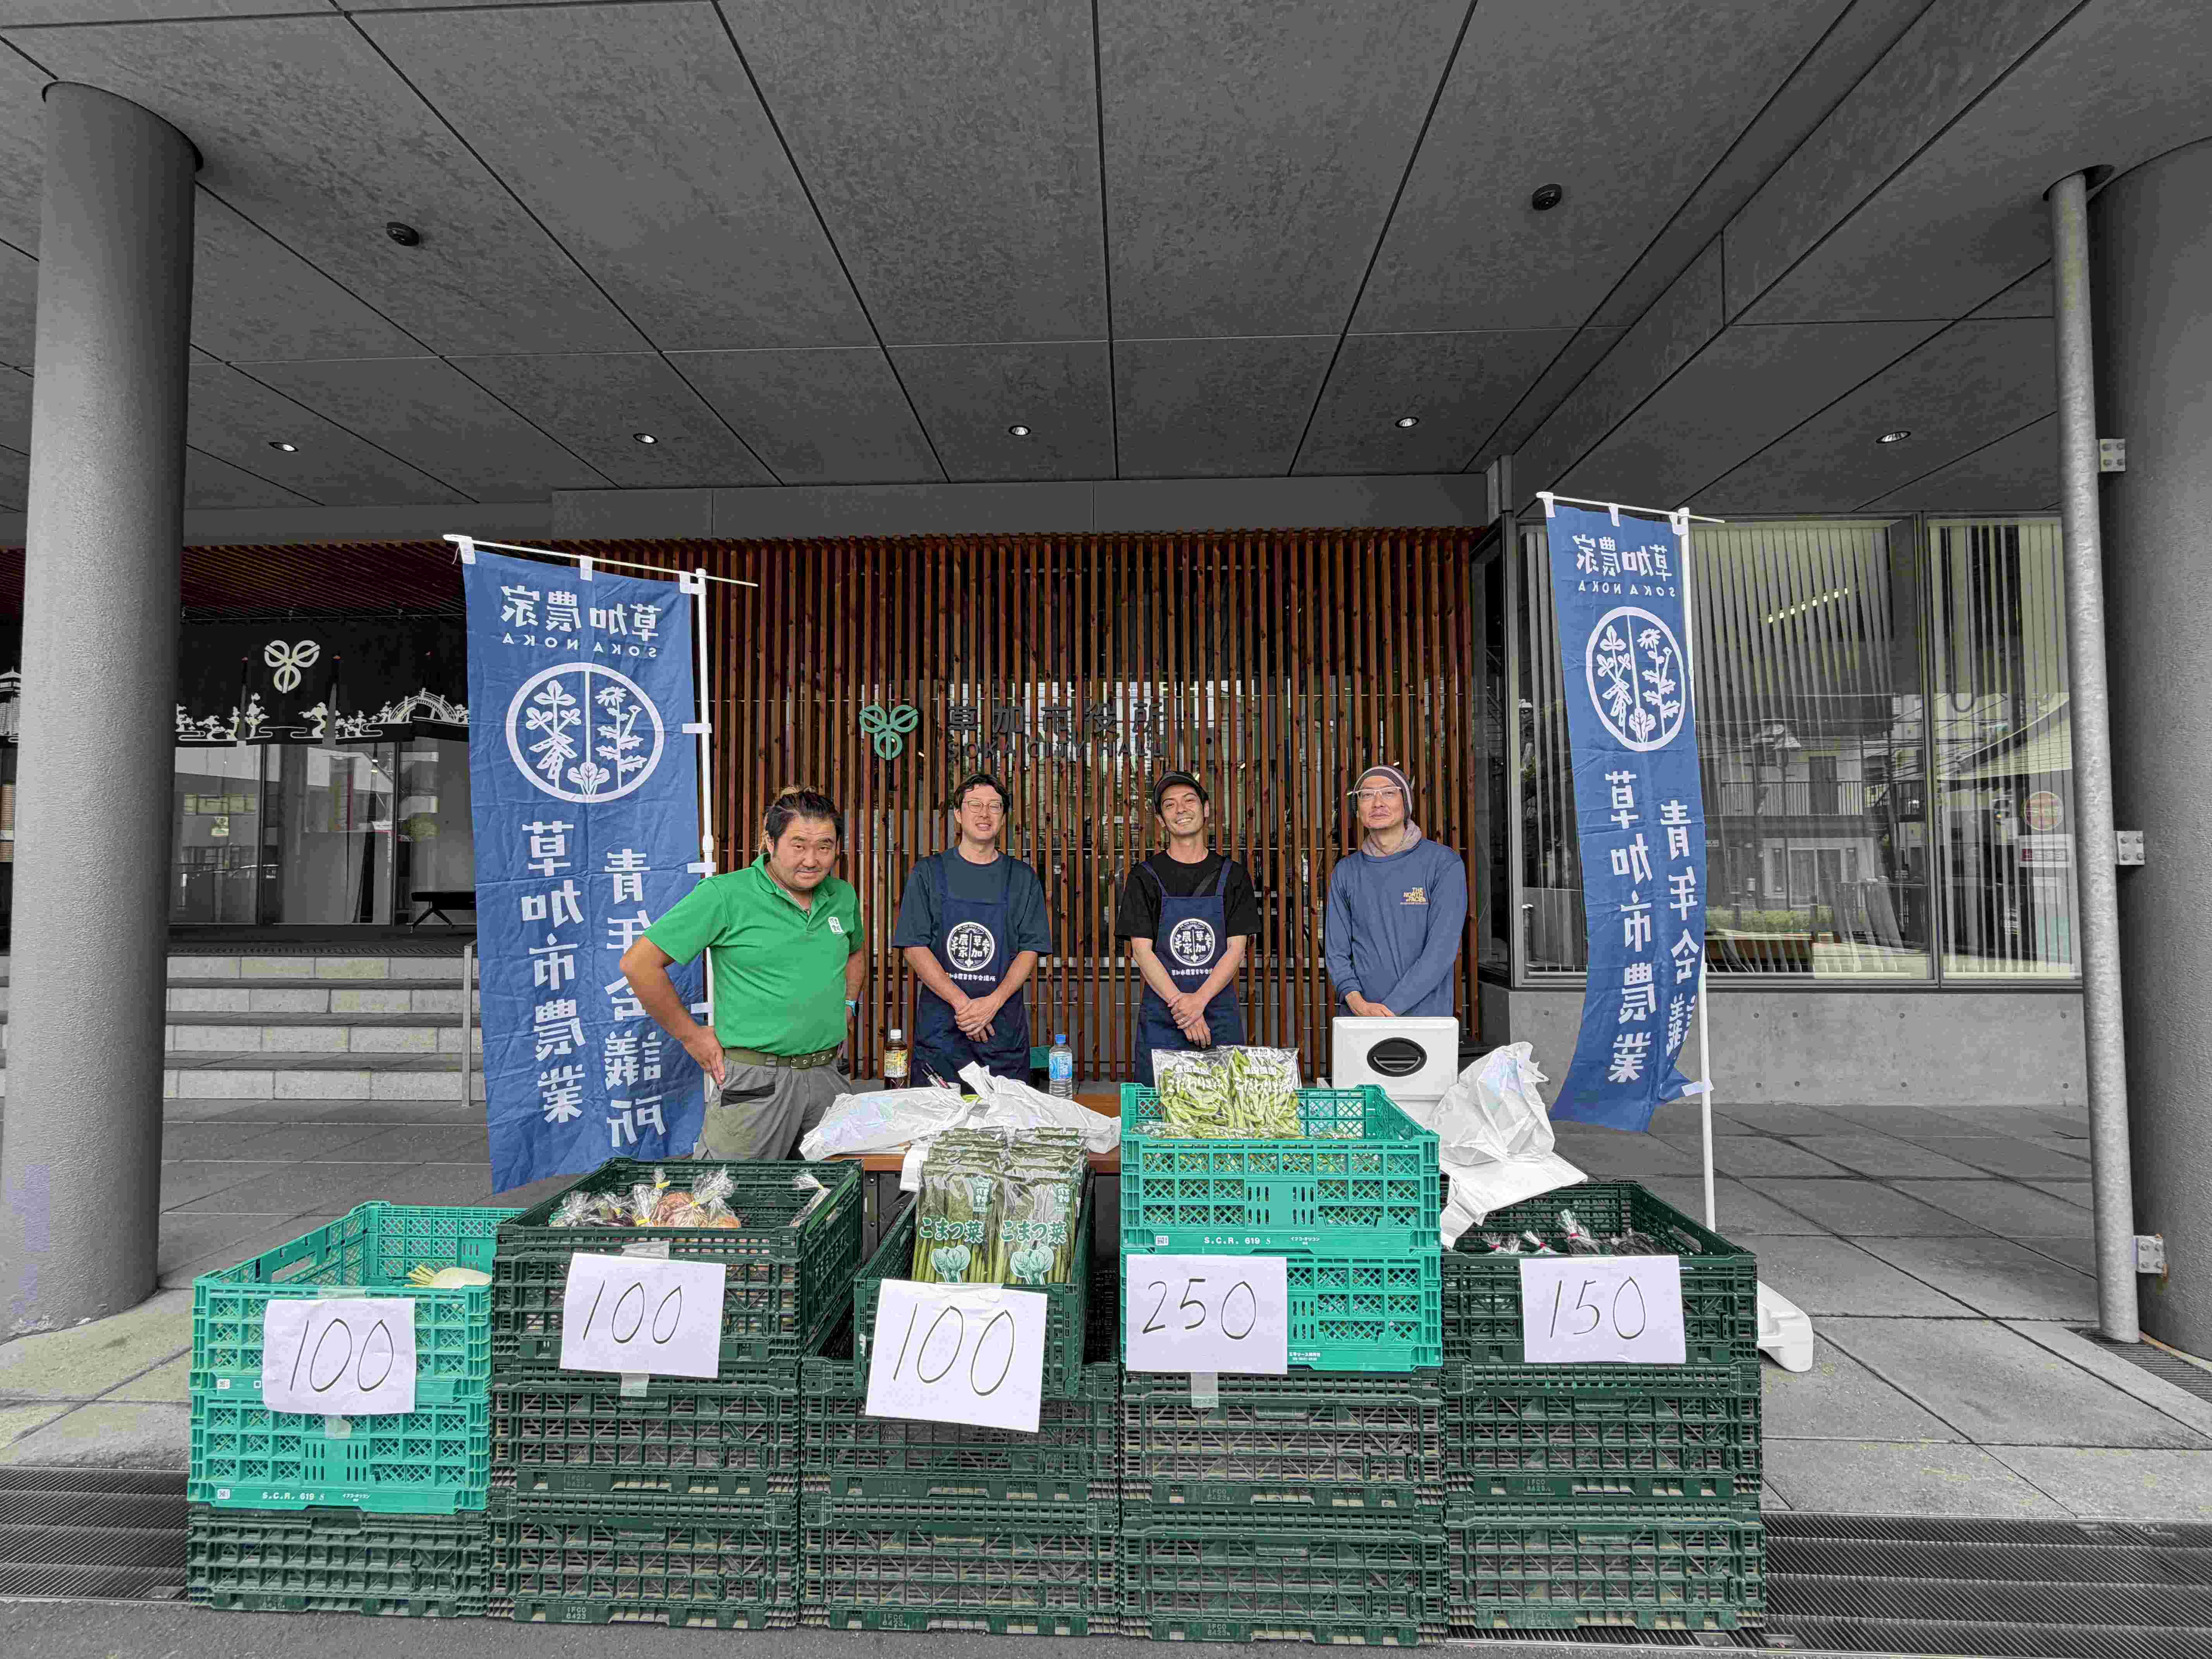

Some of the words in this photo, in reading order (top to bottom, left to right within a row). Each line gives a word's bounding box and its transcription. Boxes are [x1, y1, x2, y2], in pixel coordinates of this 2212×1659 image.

[948, 702, 1163, 735] 草加市役所
[948, 740, 1017, 758] SOKA
[1027, 740, 1086, 758] CITY
[1097, 741, 1166, 757] HALL
[920, 1217, 985, 1243] こまつ菜
[1000, 1220, 1066, 1244] こまつ菜
[583, 1280, 682, 1344] 100
[1142, 1278, 1256, 1340] 250
[1550, 1276, 1645, 1340] 150
[290, 1318, 394, 1393] 100
[893, 1304, 1014, 1396] 100
